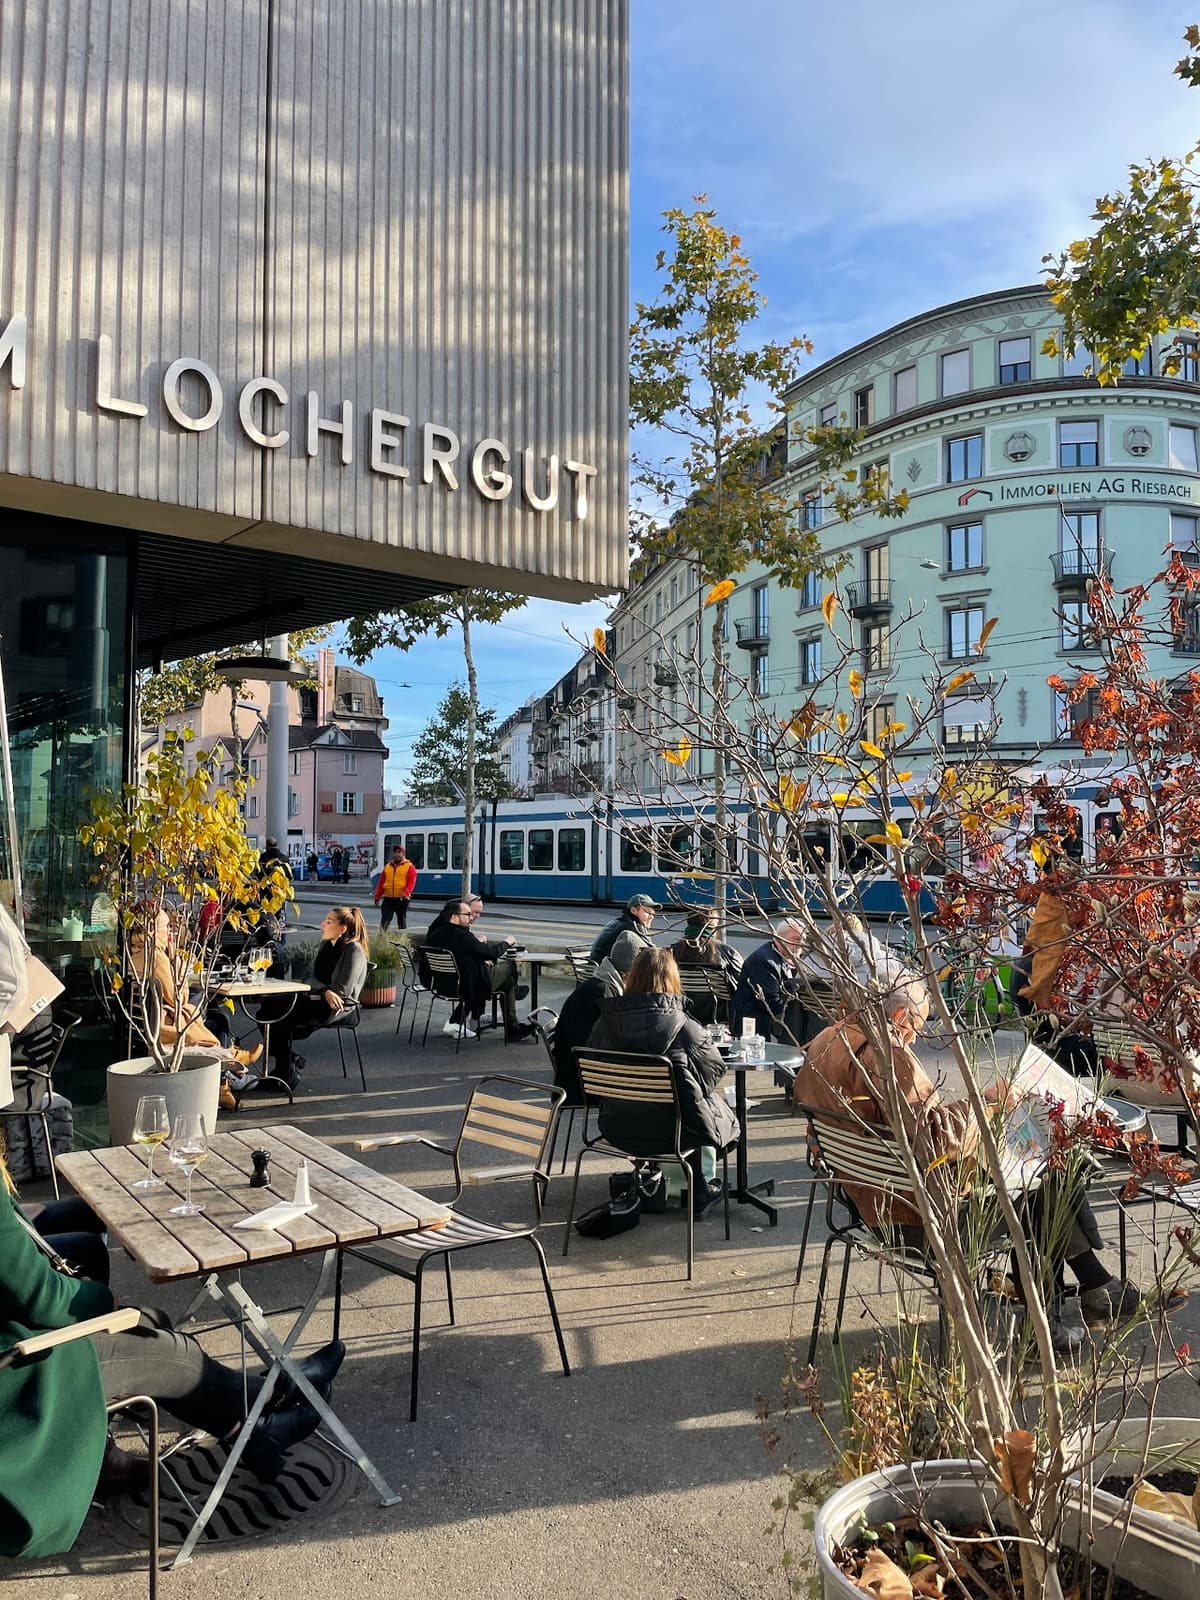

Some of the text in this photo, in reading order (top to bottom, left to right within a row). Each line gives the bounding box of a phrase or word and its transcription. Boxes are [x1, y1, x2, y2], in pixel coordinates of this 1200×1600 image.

[97, 334, 598, 519] LOCHERGUT
[1097, 478, 1125, 493] AG
[1131, 479, 1191, 498] RIESBACH
